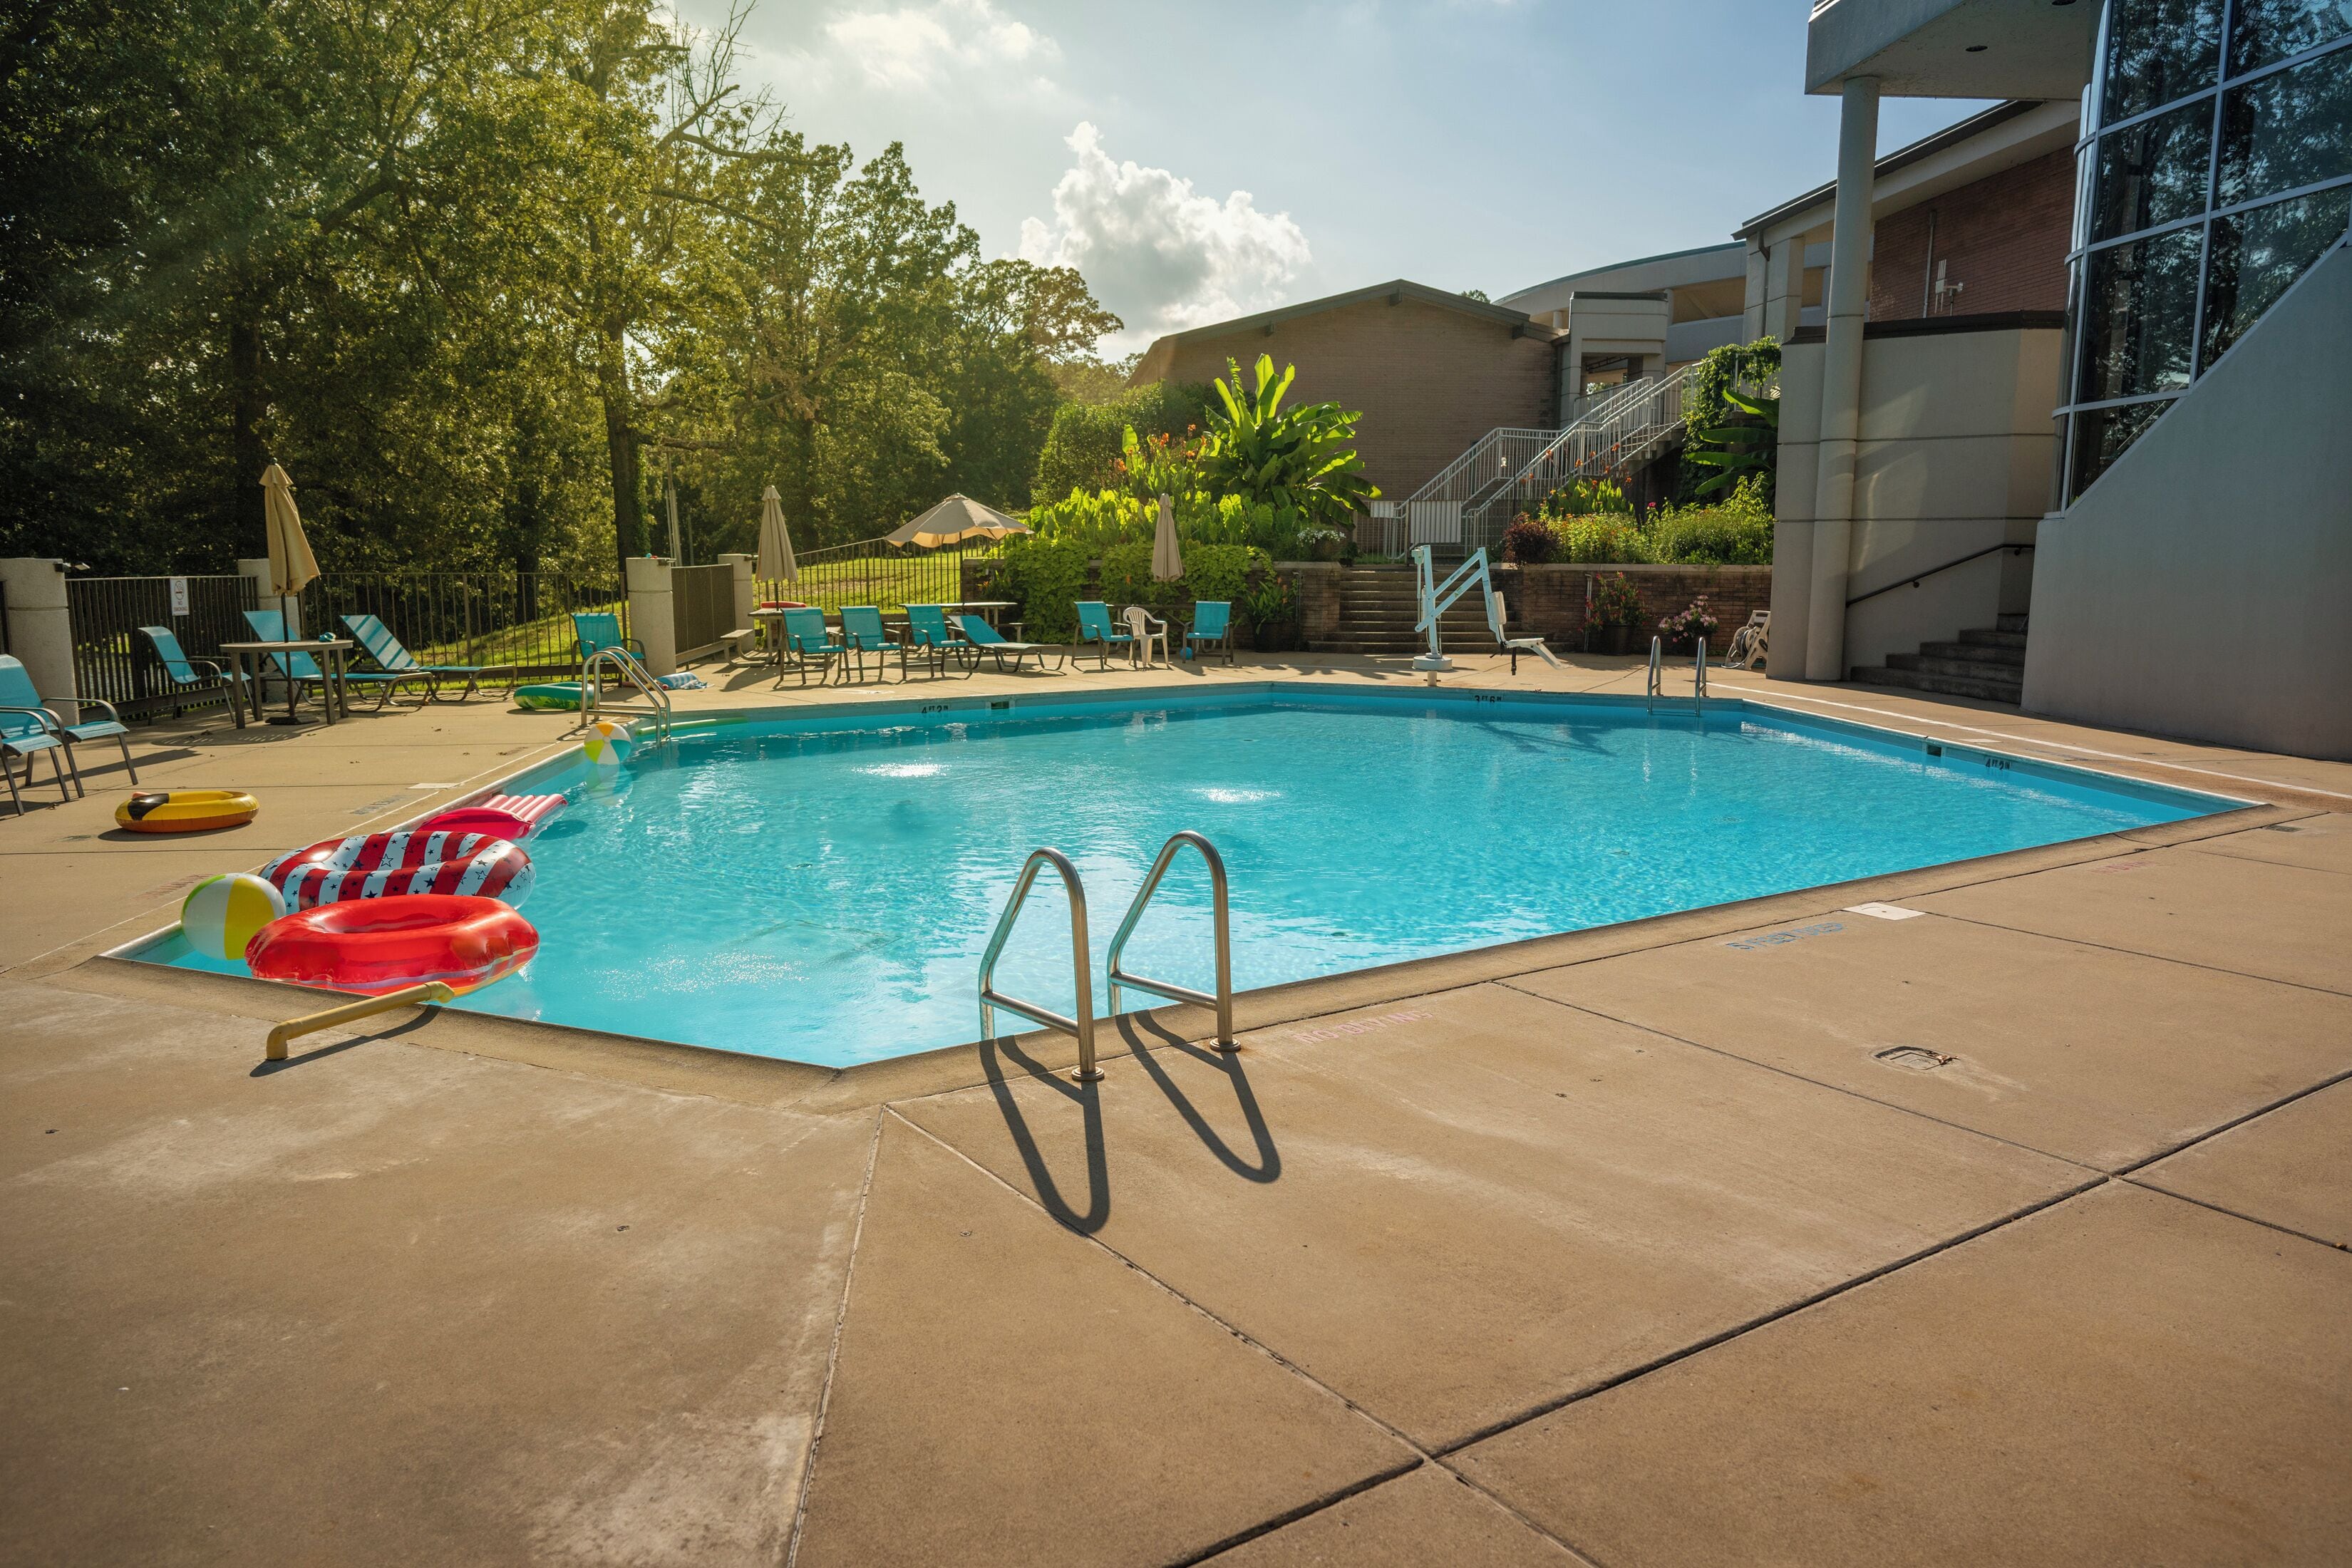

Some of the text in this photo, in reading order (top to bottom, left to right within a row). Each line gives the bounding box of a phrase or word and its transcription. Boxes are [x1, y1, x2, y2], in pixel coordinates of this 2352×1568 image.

[1986, 758, 1991, 768] 4
[1998, 760, 2004, 770] 2
[1292, 1010, 1433, 1044] NO DIVING
